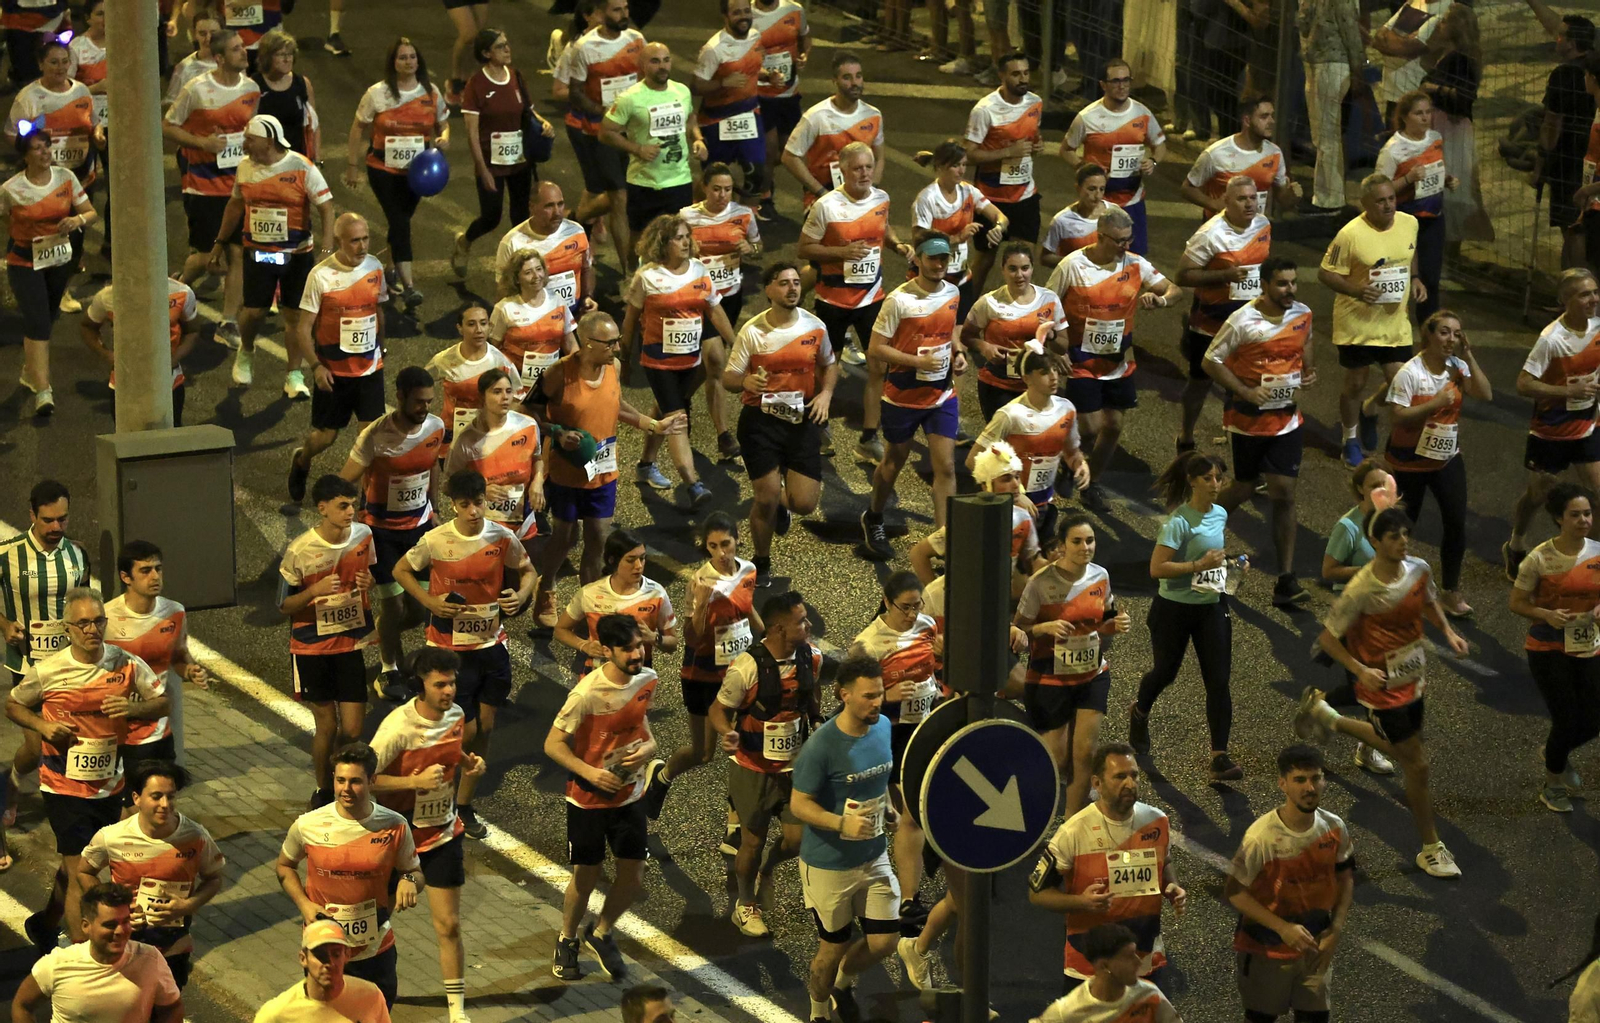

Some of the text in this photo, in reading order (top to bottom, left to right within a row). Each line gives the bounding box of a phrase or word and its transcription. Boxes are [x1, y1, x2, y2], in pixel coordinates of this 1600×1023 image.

[655, 115, 682, 128] 12549
[727, 119, 749, 131] 3546
[54, 150, 84, 161] 15079
[392, 149, 416, 160] 2687
[498, 144, 520, 156] 2662
[253, 221, 283, 233] 15074
[37, 244, 69, 260] 20110
[852, 262, 876, 275] 8476
[1236, 279, 1261, 292] 1694
[352, 331, 370, 344] 871
[668, 332, 698, 344] 15204
[1088, 333, 1119, 345] 16946
[1425, 436, 1454, 451] 13859
[397, 487, 423, 503] 3287
[489, 499, 517, 512] 3286
[322, 605, 358, 624] 11885
[458, 619, 494, 633] 23637
[721, 636, 749, 654] 13879
[1061, 648, 1095, 664] 11439
[73, 754, 111, 769] 13969
[1114, 867, 1152, 884] 24140
[339, 916, 369, 936] 169
